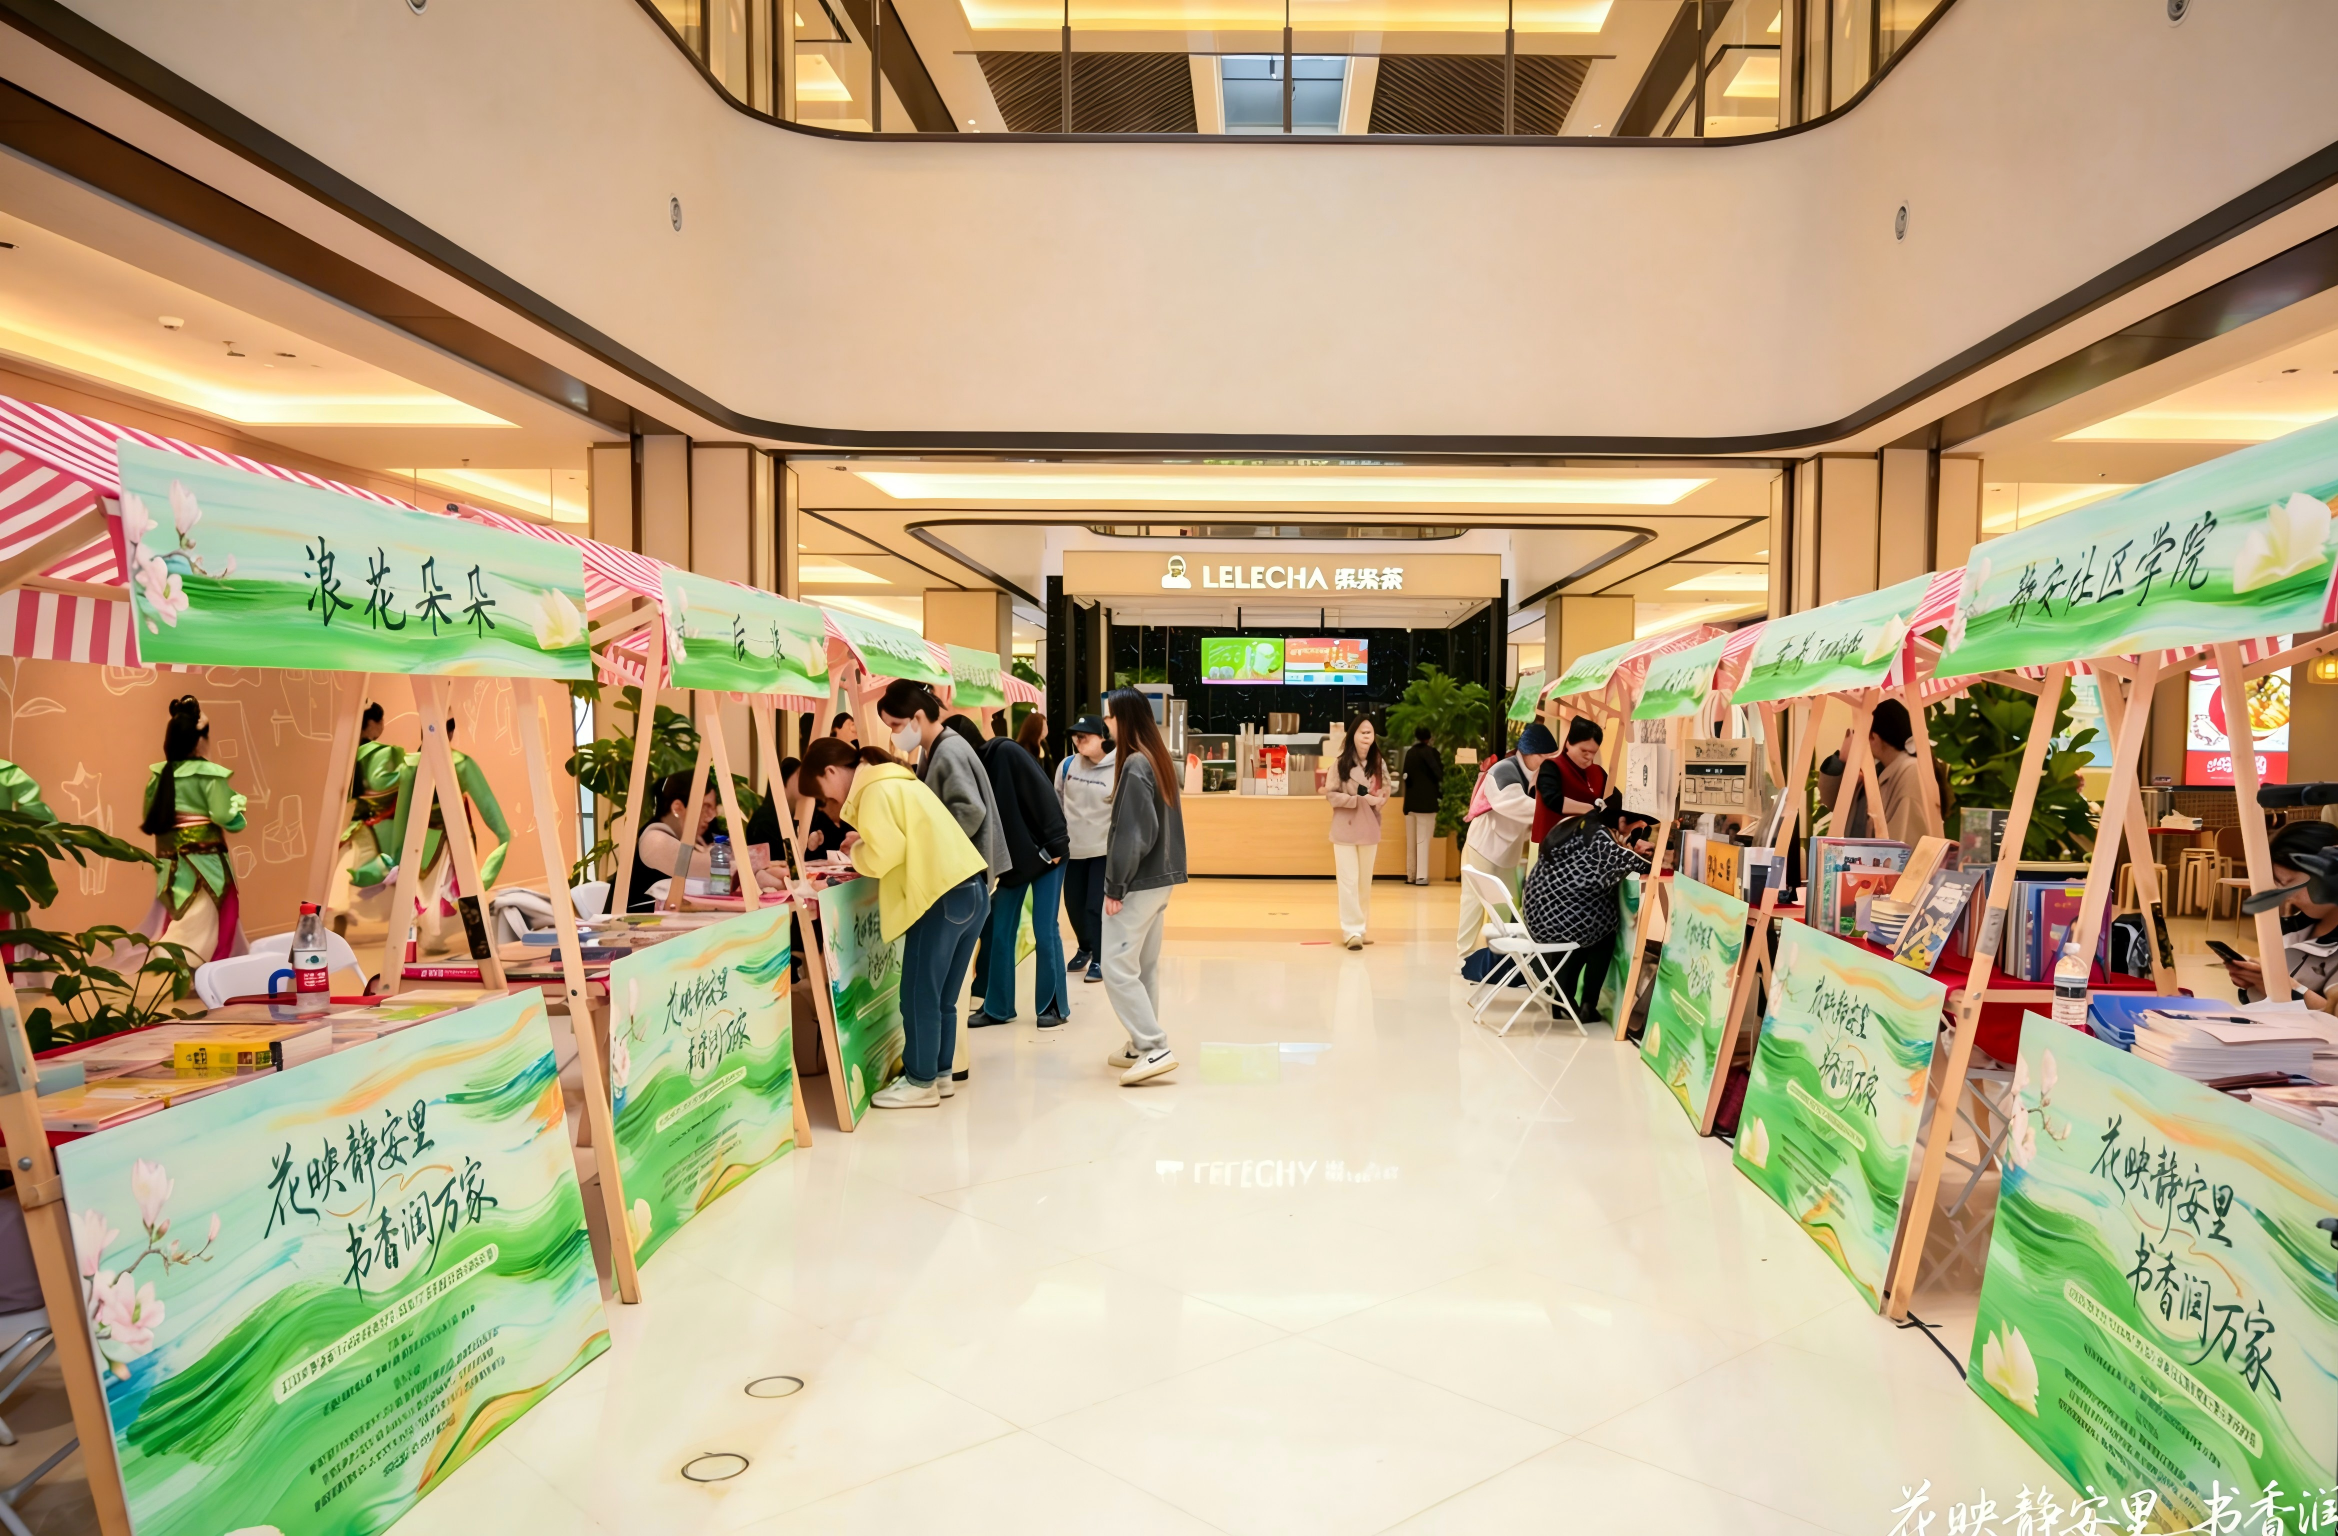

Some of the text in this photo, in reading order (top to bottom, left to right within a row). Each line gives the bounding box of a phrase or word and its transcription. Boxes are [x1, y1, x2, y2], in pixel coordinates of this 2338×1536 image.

[304, 535, 497, 639] 浪花朵朵
[1203, 565, 1329, 590] LELECHA
[2007, 510, 2218, 628] 静安社区学院
[264, 1098, 435, 1240] 花映静安里
[343, 1155, 499, 1303] 书香润万家
[2089, 1113, 2234, 1248] 花映静安里
[2125, 1231, 2282, 1403] 书香润万家
